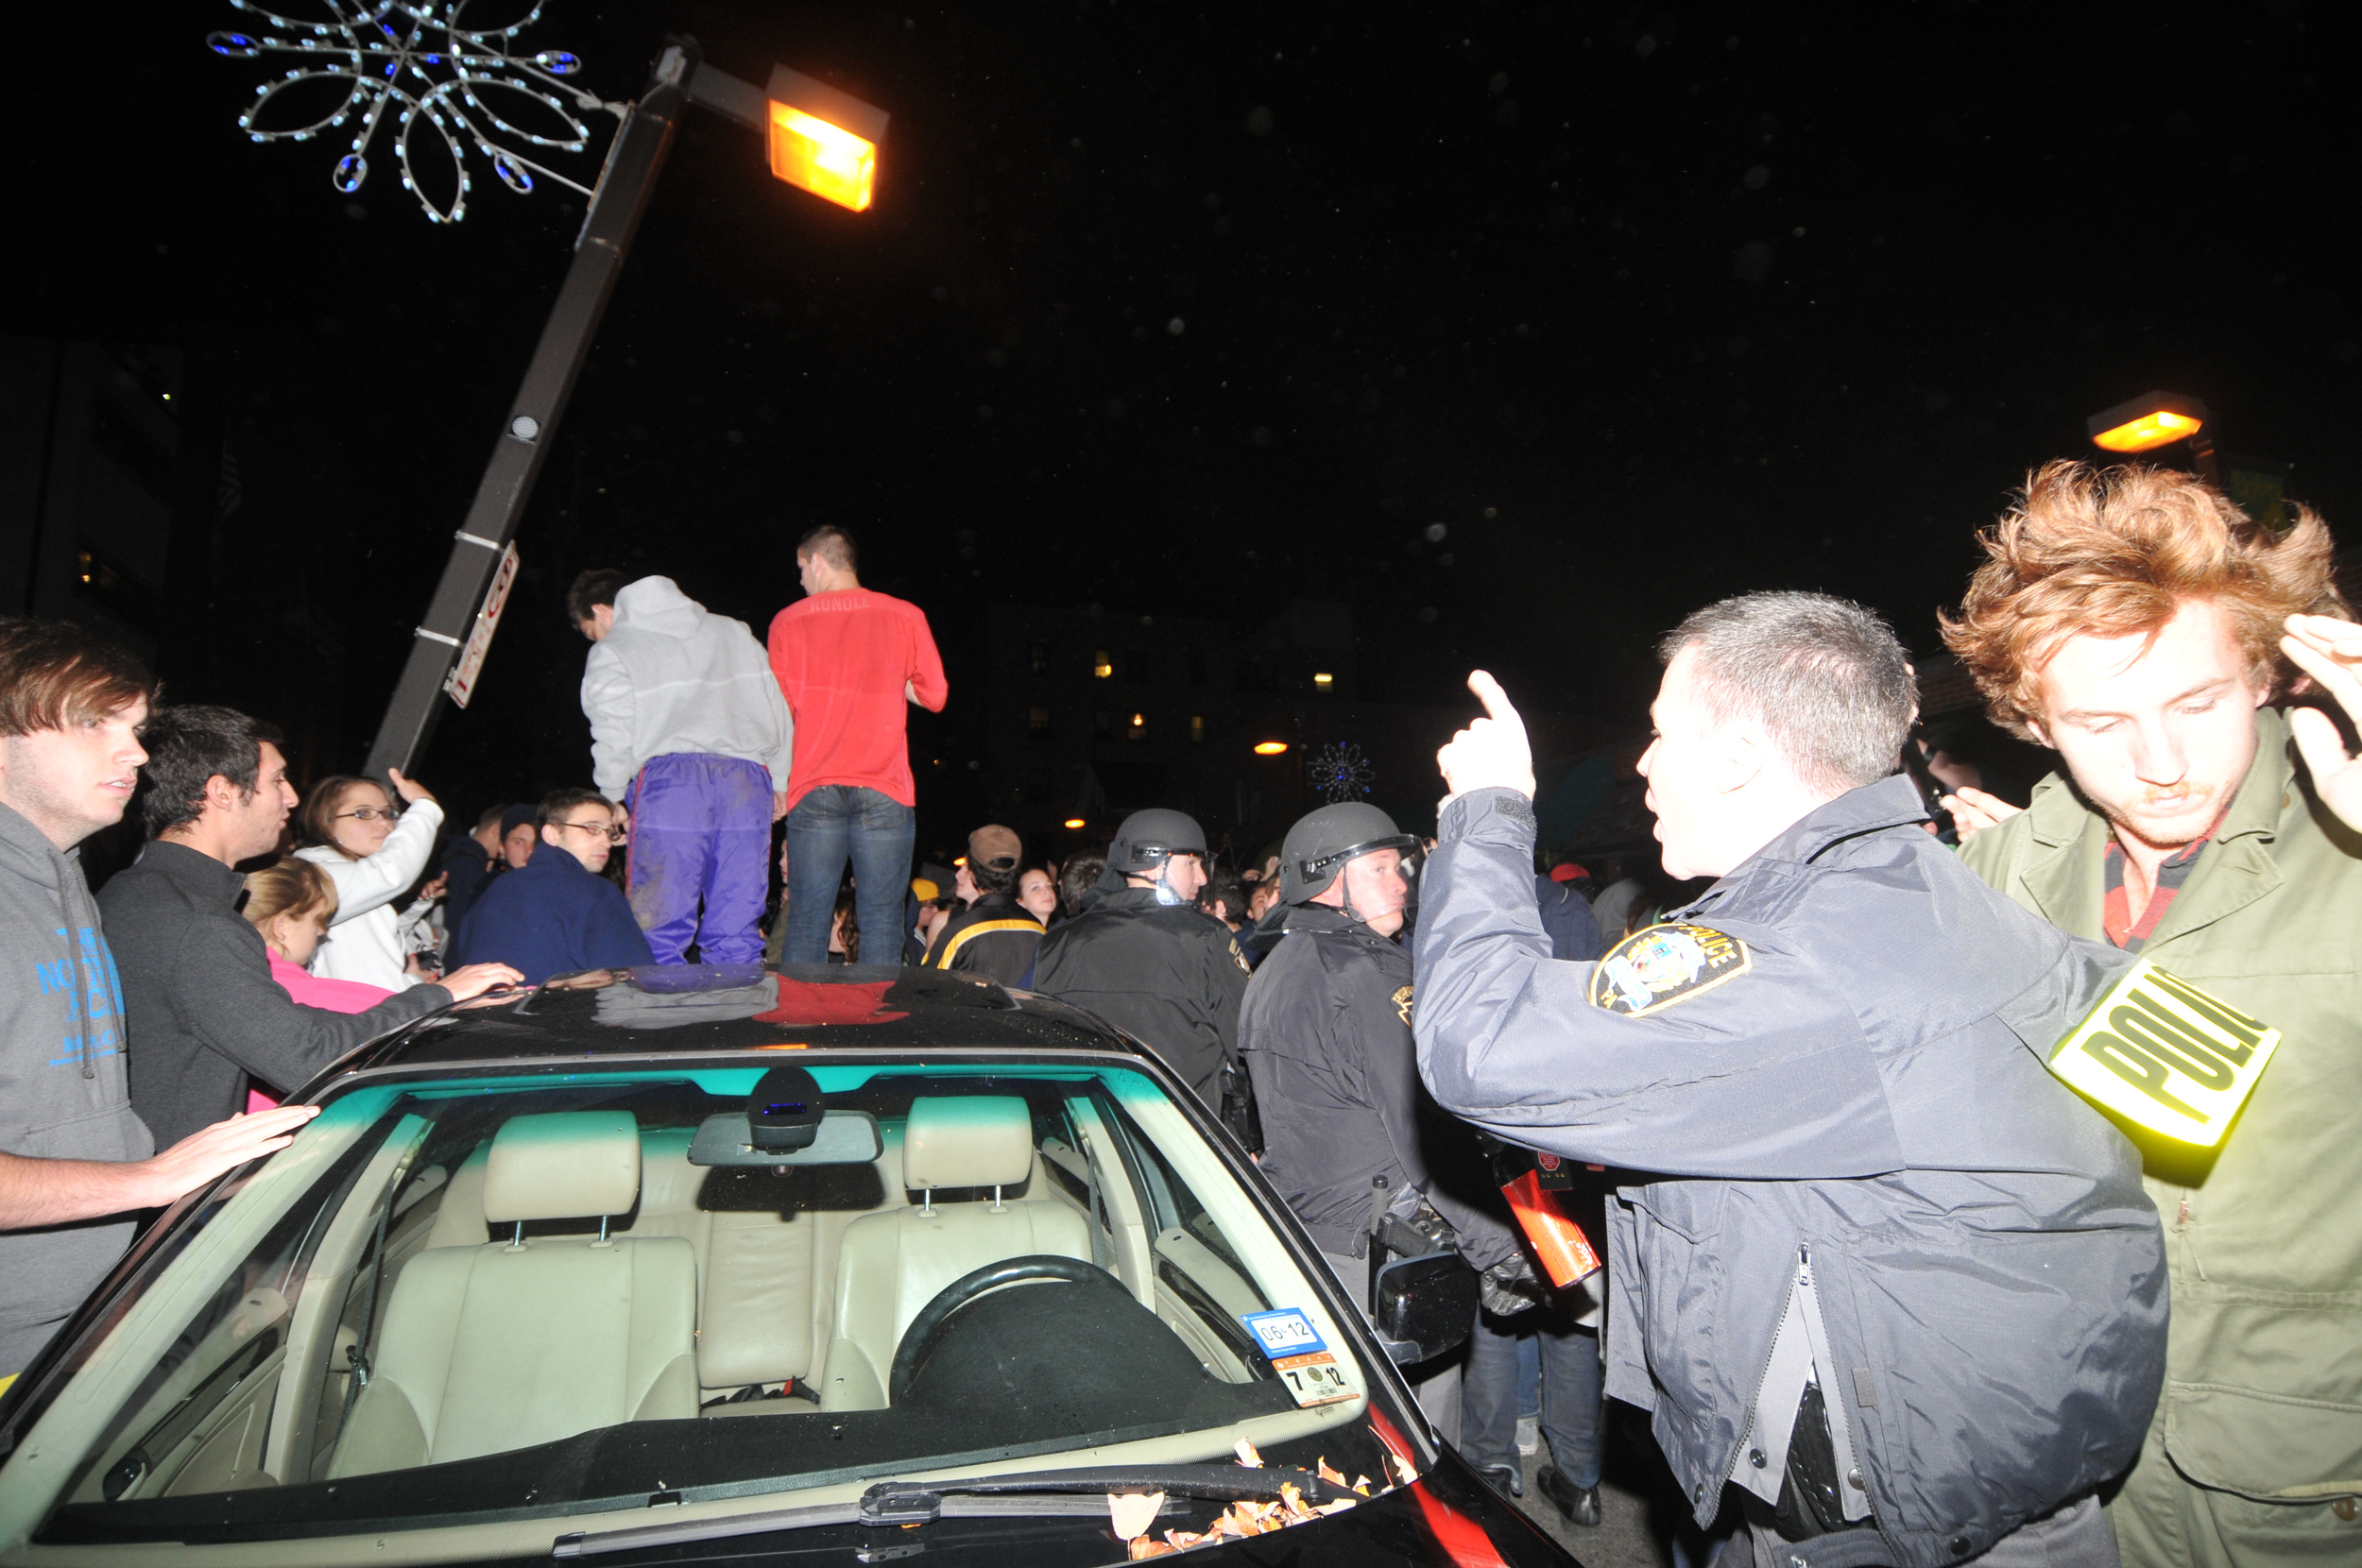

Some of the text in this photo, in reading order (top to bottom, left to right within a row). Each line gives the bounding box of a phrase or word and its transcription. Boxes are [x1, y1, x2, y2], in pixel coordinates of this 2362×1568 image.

[1677, 926, 1738, 969] POLICE
[1286, 1366, 1346, 1391] 7 12
